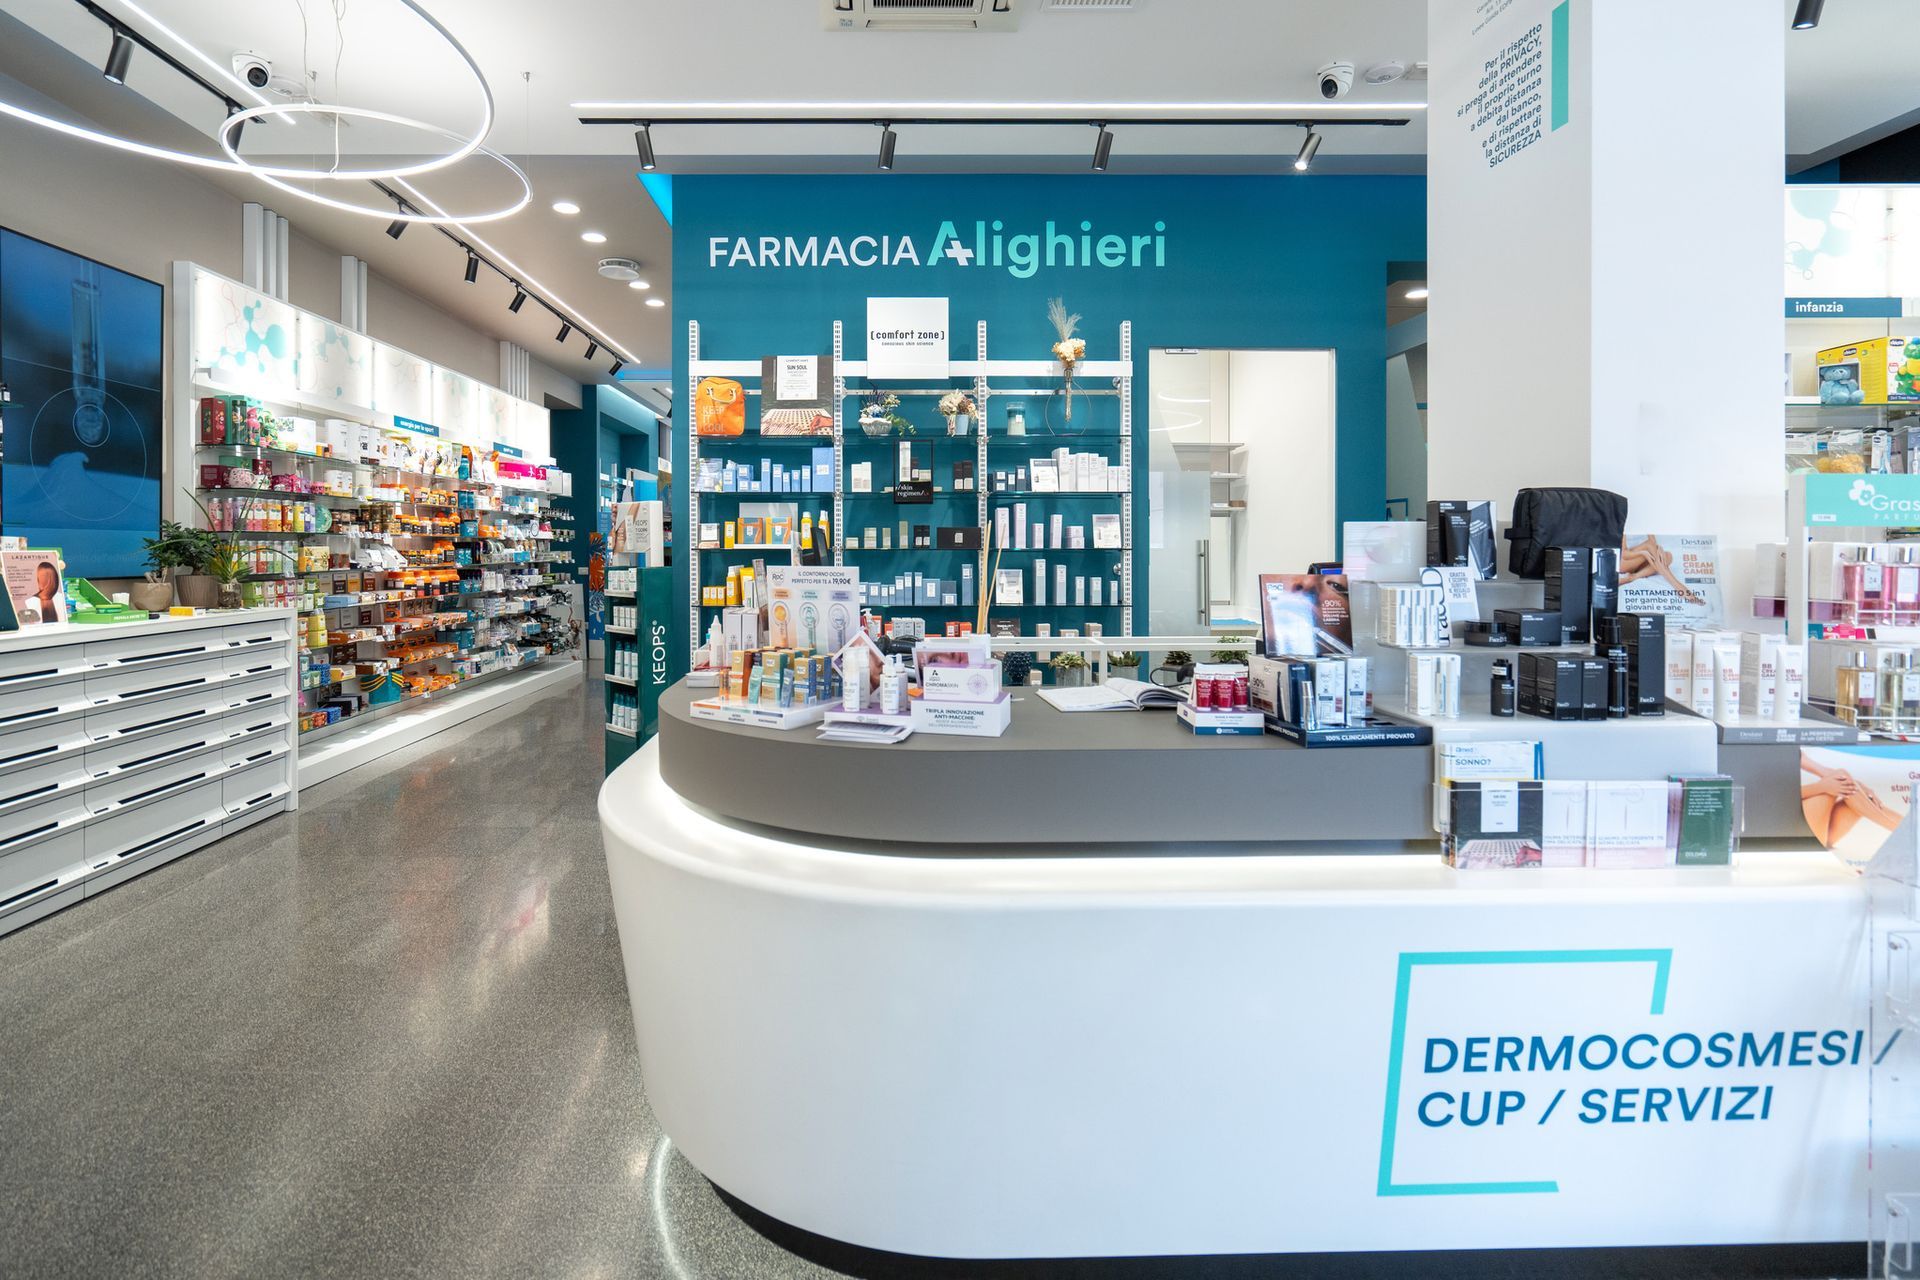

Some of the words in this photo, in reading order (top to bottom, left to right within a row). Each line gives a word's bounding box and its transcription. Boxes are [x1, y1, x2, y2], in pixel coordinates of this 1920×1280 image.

[1478, 70, 1498, 89] della
[1500, 35, 1542, 73] PRIVACY,
[1484, 56, 1498, 72] Per
[1500, 49, 1505, 61] il
[1507, 23, 1542, 54] rispetto
[1457, 107, 1463, 117] si
[1465, 90, 1487, 114] prega
[1489, 81, 1497, 93] di
[1499, 50, 1542, 87] attendere
[1470, 123, 1475, 132] a
[1477, 104, 1502, 127] debita
[1504, 77, 1542, 108] distanza
[1478, 104, 1483, 115] il
[1485, 82, 1515, 111] proprio
[1517, 64, 1542, 86] turno
[1482, 140, 1487, 148] e
[1489, 132, 1497, 143] di
[1499, 104, 1542, 138] rispettare
[1496, 111, 1509, 126] dal
[1511, 92, 1542, 116] banco,
[1485, 148, 1492, 159] la
[1494, 125, 1530, 152] distanza
[1533, 115, 1541, 129] di
[1489, 129, 1542, 168] SICUREZZA
[709, 235, 920, 267] FARMACIA
[927, 220, 1166, 278] Alighieri
[1795, 301, 1844, 312] infanzia
[702, 406, 725, 415] KEEP
[703, 414, 711, 424] IT
[1626, 604, 1655, 612] giovani
[1640, 596, 1668, 605] gambe
[1670, 596, 1683, 605] più
[1387, 732, 1416, 740] PROVATO
[1456, 758, 1492, 766] SONNO?
[1423, 1029, 1864, 1074] DERMOCOSMESI
[1417, 1089, 1526, 1128] CUP
[1578, 1085, 1774, 1124] SERVIZI
